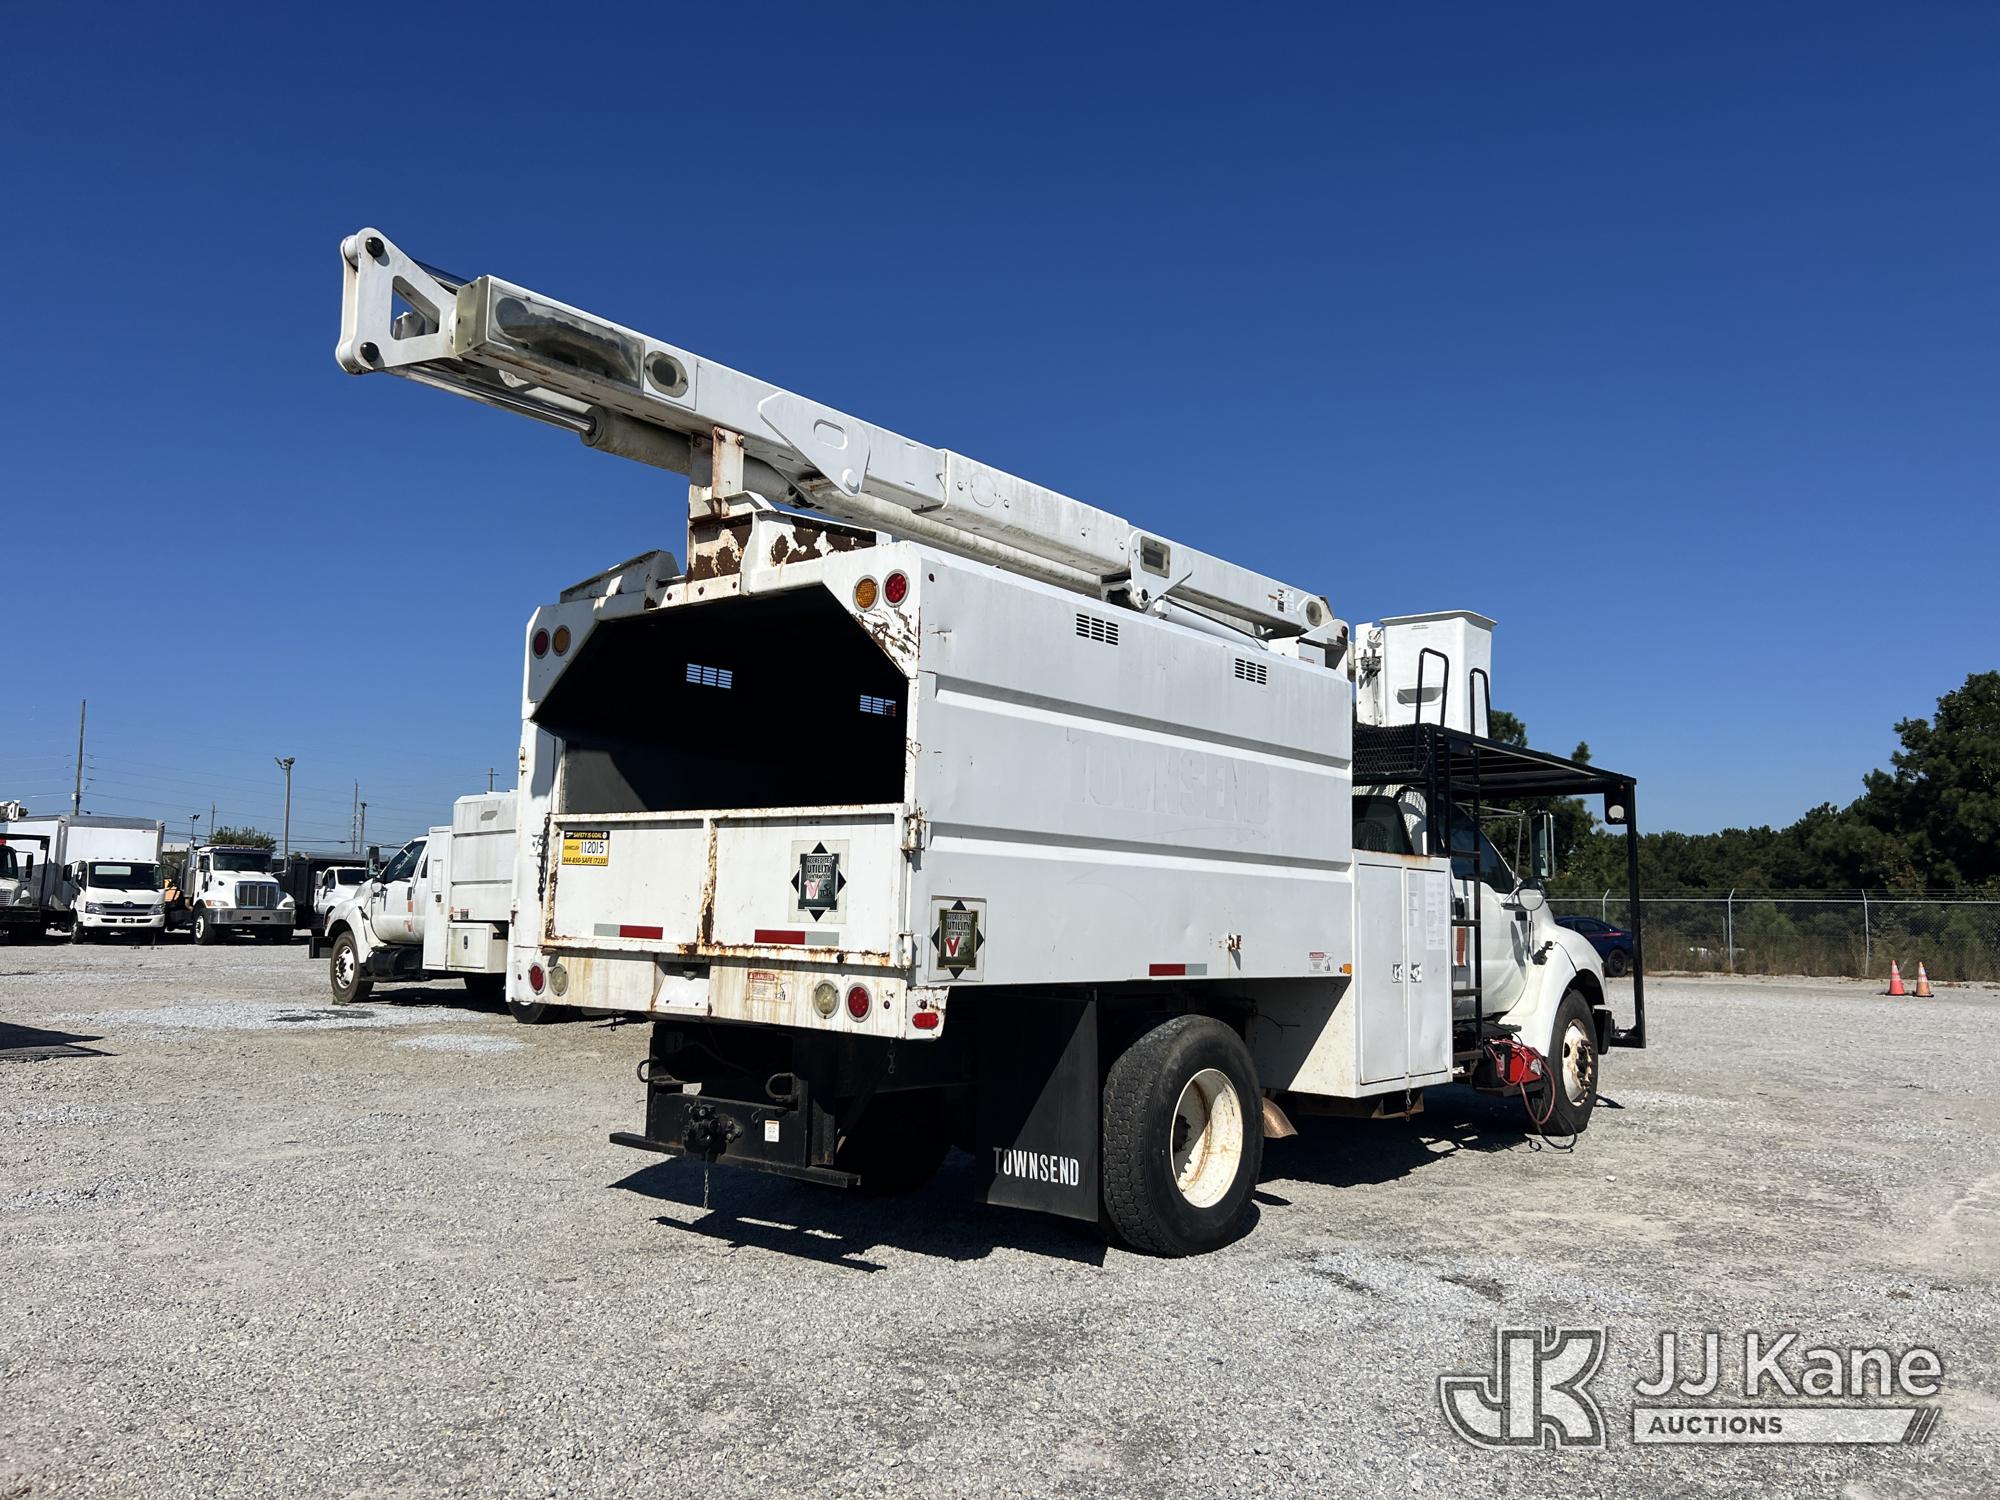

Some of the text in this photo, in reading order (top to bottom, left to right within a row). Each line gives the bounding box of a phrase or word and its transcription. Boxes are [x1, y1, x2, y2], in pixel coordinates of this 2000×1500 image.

[581, 841, 604, 854] 112015
[807, 864, 832, 874] UTILITY
[947, 921, 971, 931] UTILITY
[993, 1147, 1080, 1186] TOWNSEND
